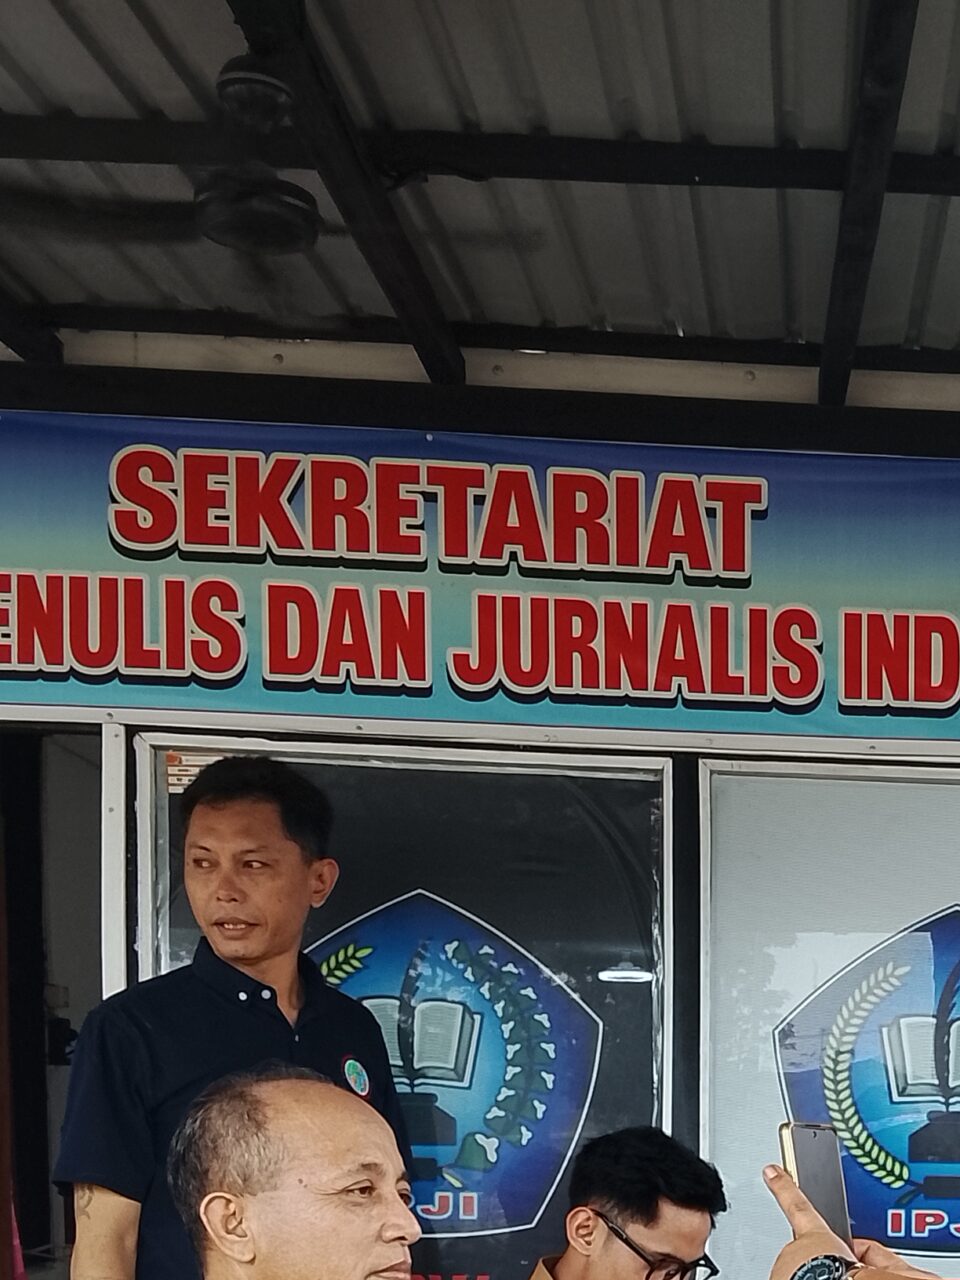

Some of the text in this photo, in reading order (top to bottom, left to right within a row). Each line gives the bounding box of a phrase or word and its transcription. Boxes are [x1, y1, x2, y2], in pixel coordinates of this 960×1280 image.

[109, 445, 768, 584] SEKRETARIAT
[263, 580, 432, 690] DAN
[447, 588, 823, 706] JURNALIS
